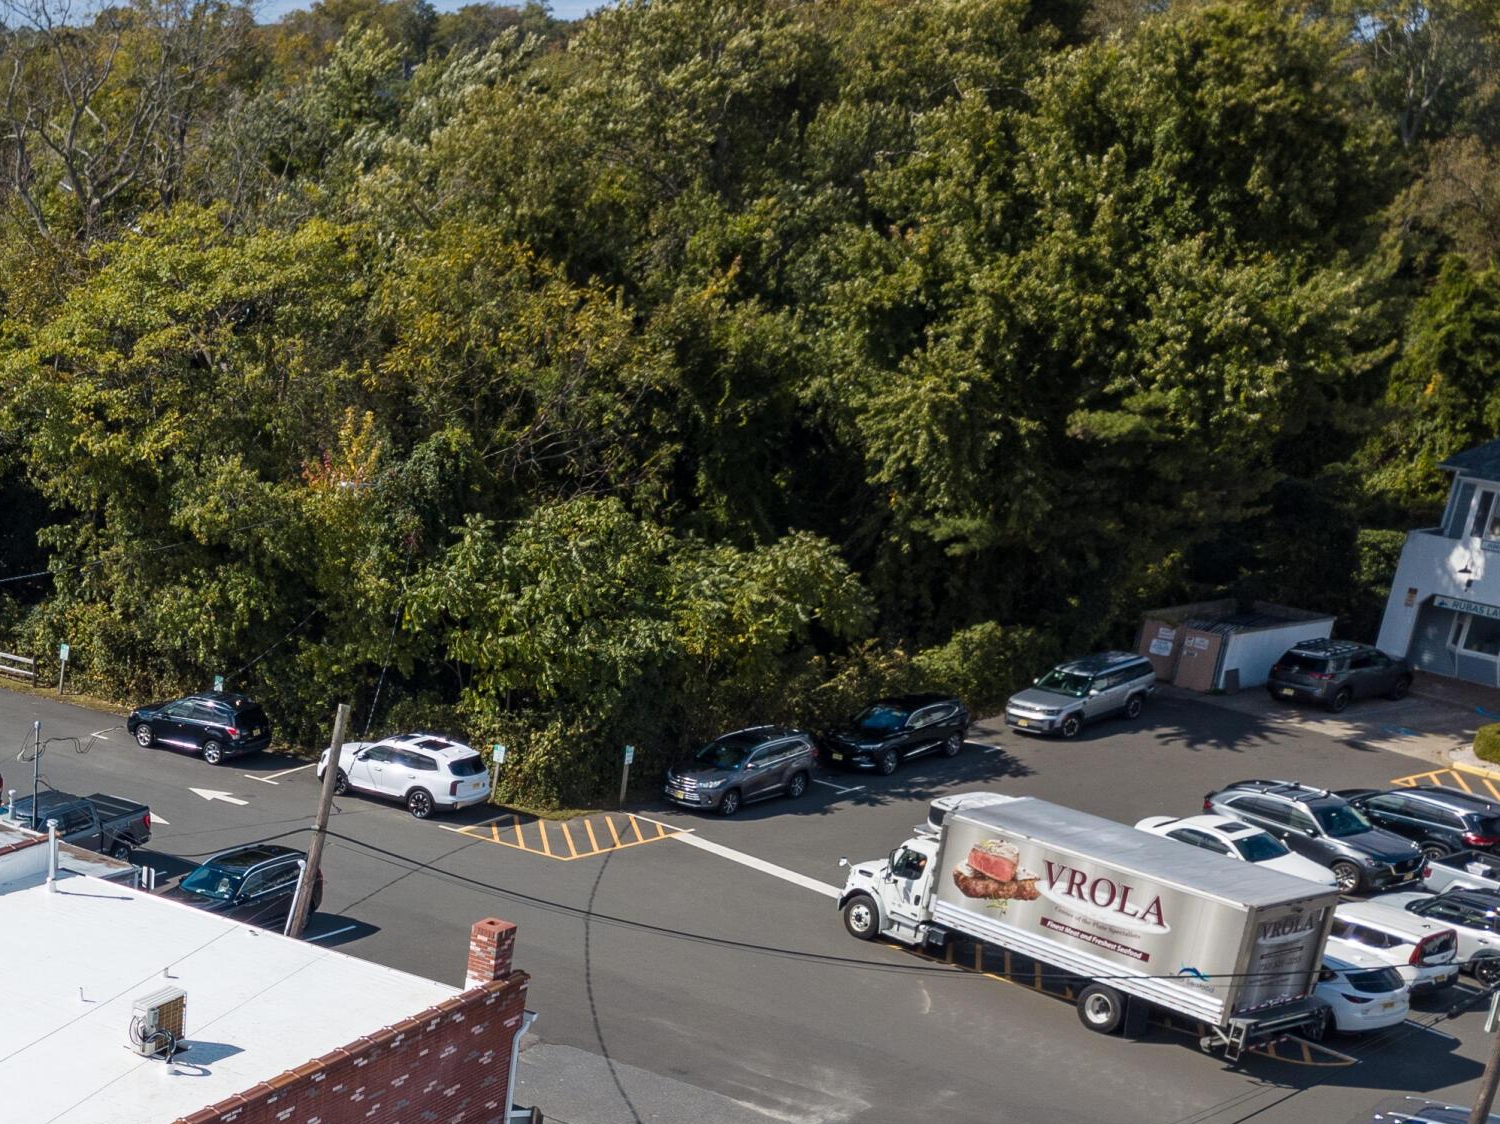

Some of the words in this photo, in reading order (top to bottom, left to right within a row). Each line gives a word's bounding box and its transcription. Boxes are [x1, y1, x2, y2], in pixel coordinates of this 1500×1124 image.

[1451, 600, 1484, 615] RUBAS
[1044, 860, 1166, 928] VROLA
[1046, 920, 1064, 932] Finest
[1064, 926, 1080, 938] Meat
[1080, 933, 1092, 942] and
[1091, 936, 1117, 951] Freshest
[1117, 944, 1143, 960] Seafood
[1261, 911, 1315, 940] VROLA
